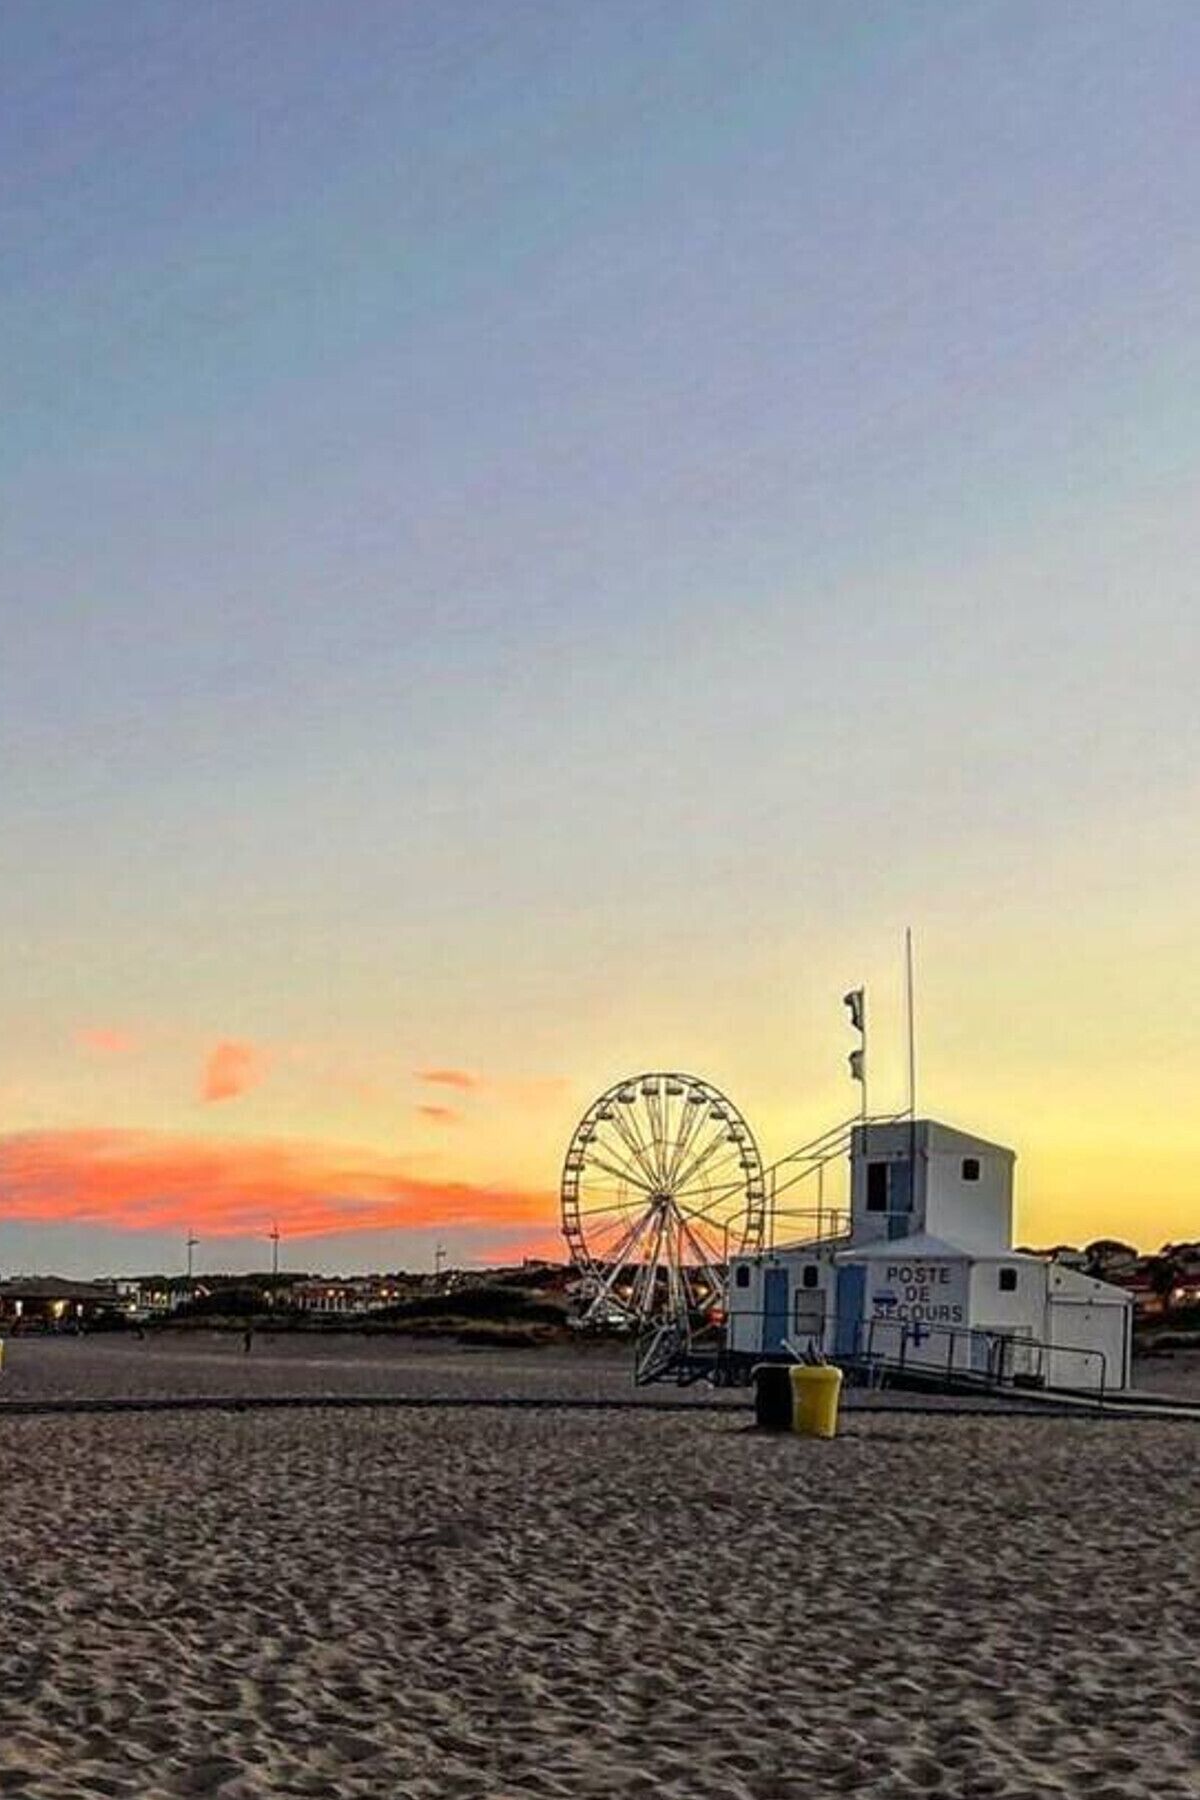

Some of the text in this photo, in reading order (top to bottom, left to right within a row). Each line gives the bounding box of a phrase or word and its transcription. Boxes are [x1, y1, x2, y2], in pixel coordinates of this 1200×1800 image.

[887, 1267, 951, 1284] POSTE
[905, 1286, 930, 1302] DE
[873, 1304, 963, 1322] SECOURS
